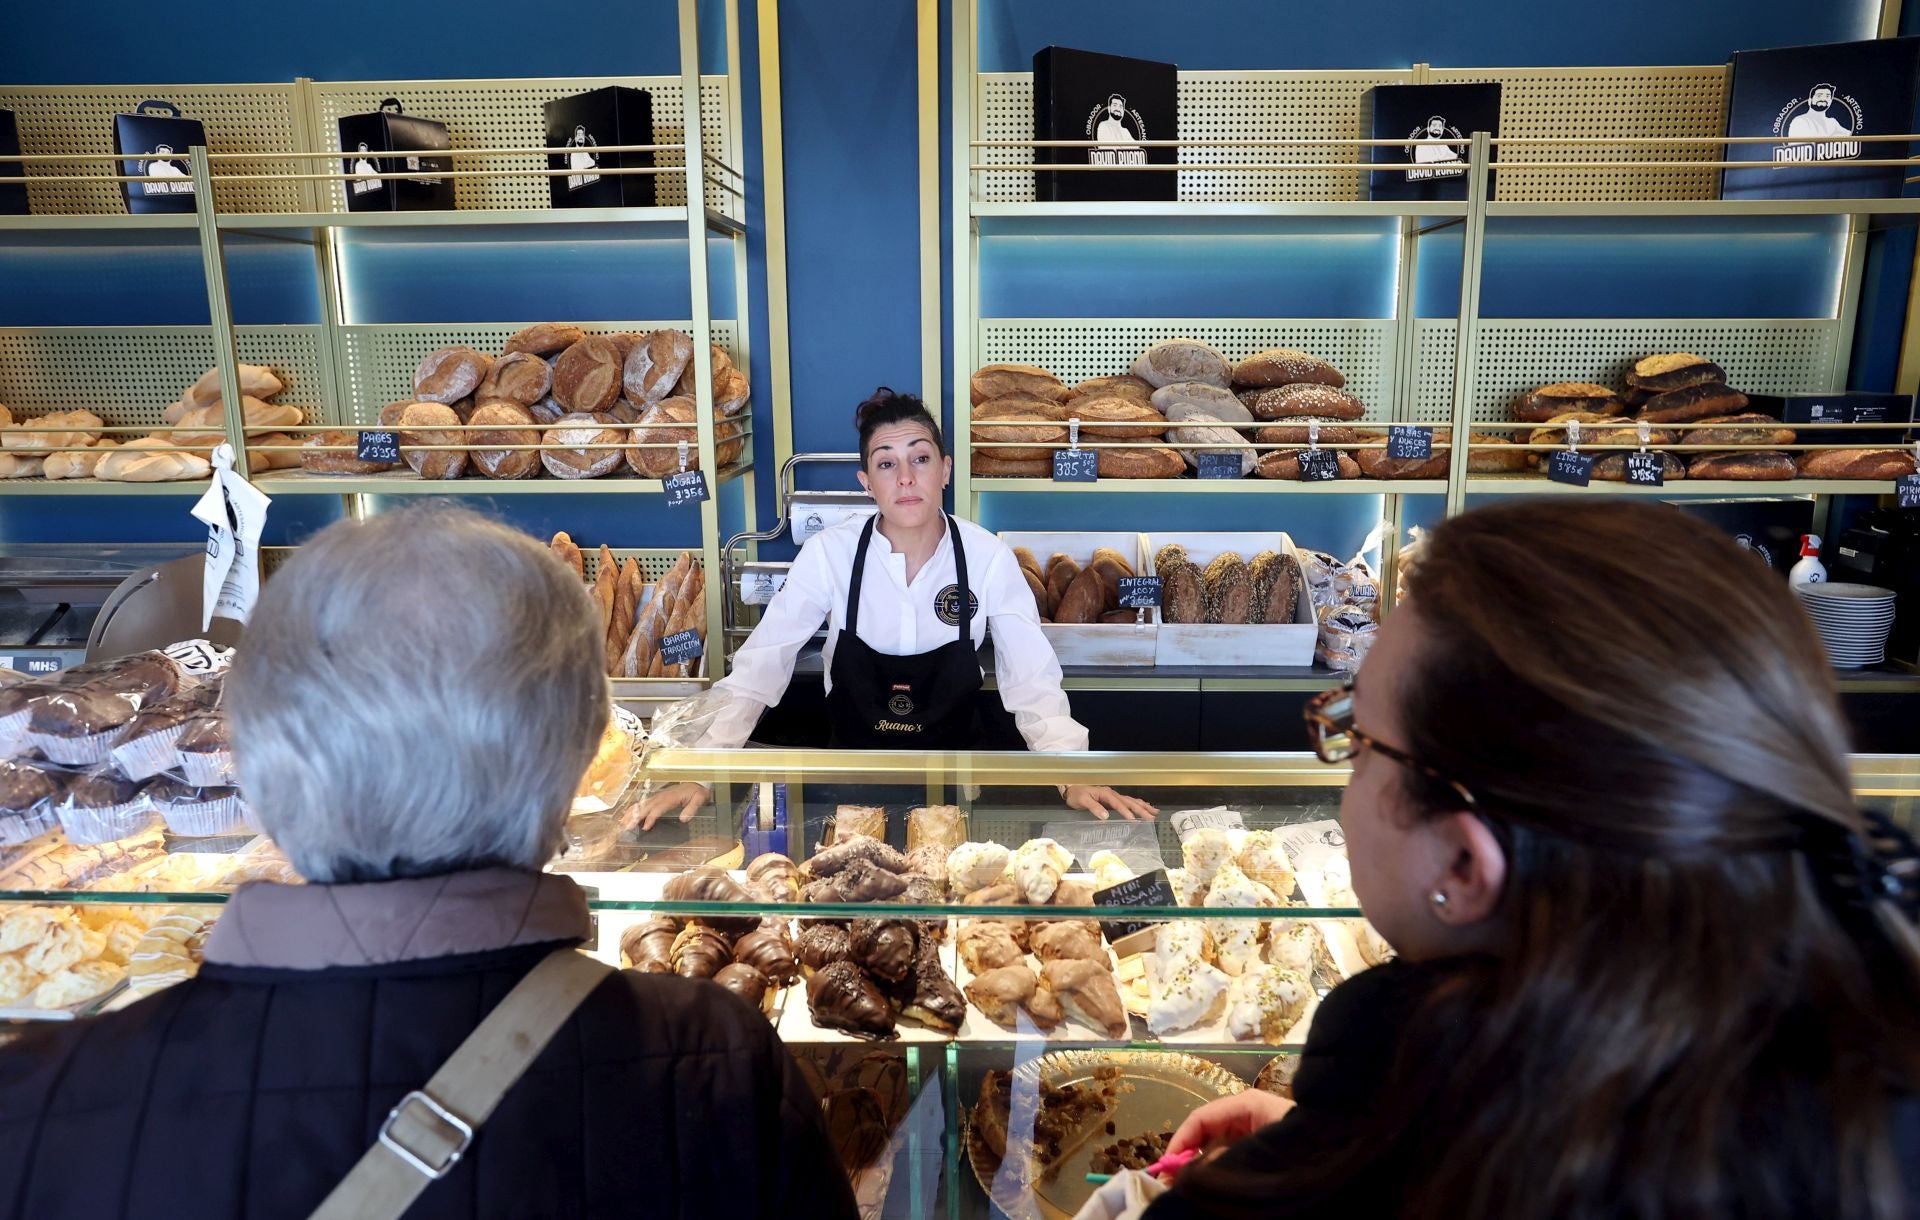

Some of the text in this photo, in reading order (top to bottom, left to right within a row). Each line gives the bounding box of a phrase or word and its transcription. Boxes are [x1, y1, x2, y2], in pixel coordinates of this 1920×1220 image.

[1086, 103, 1102, 135] OBRADOR
[1773, 98, 1798, 133] OBRADOR
[1844, 95, 1864, 130] ARTESANO
[1090, 150, 1146, 165] DAVID RUANO
[1776, 144, 1813, 162] DAVID
[144, 182, 169, 194] DAVID
[1120, 577, 1162, 587] INTEGRAL
[28, 661, 58, 671] MHS
[874, 719, 923, 732] Ruano's
